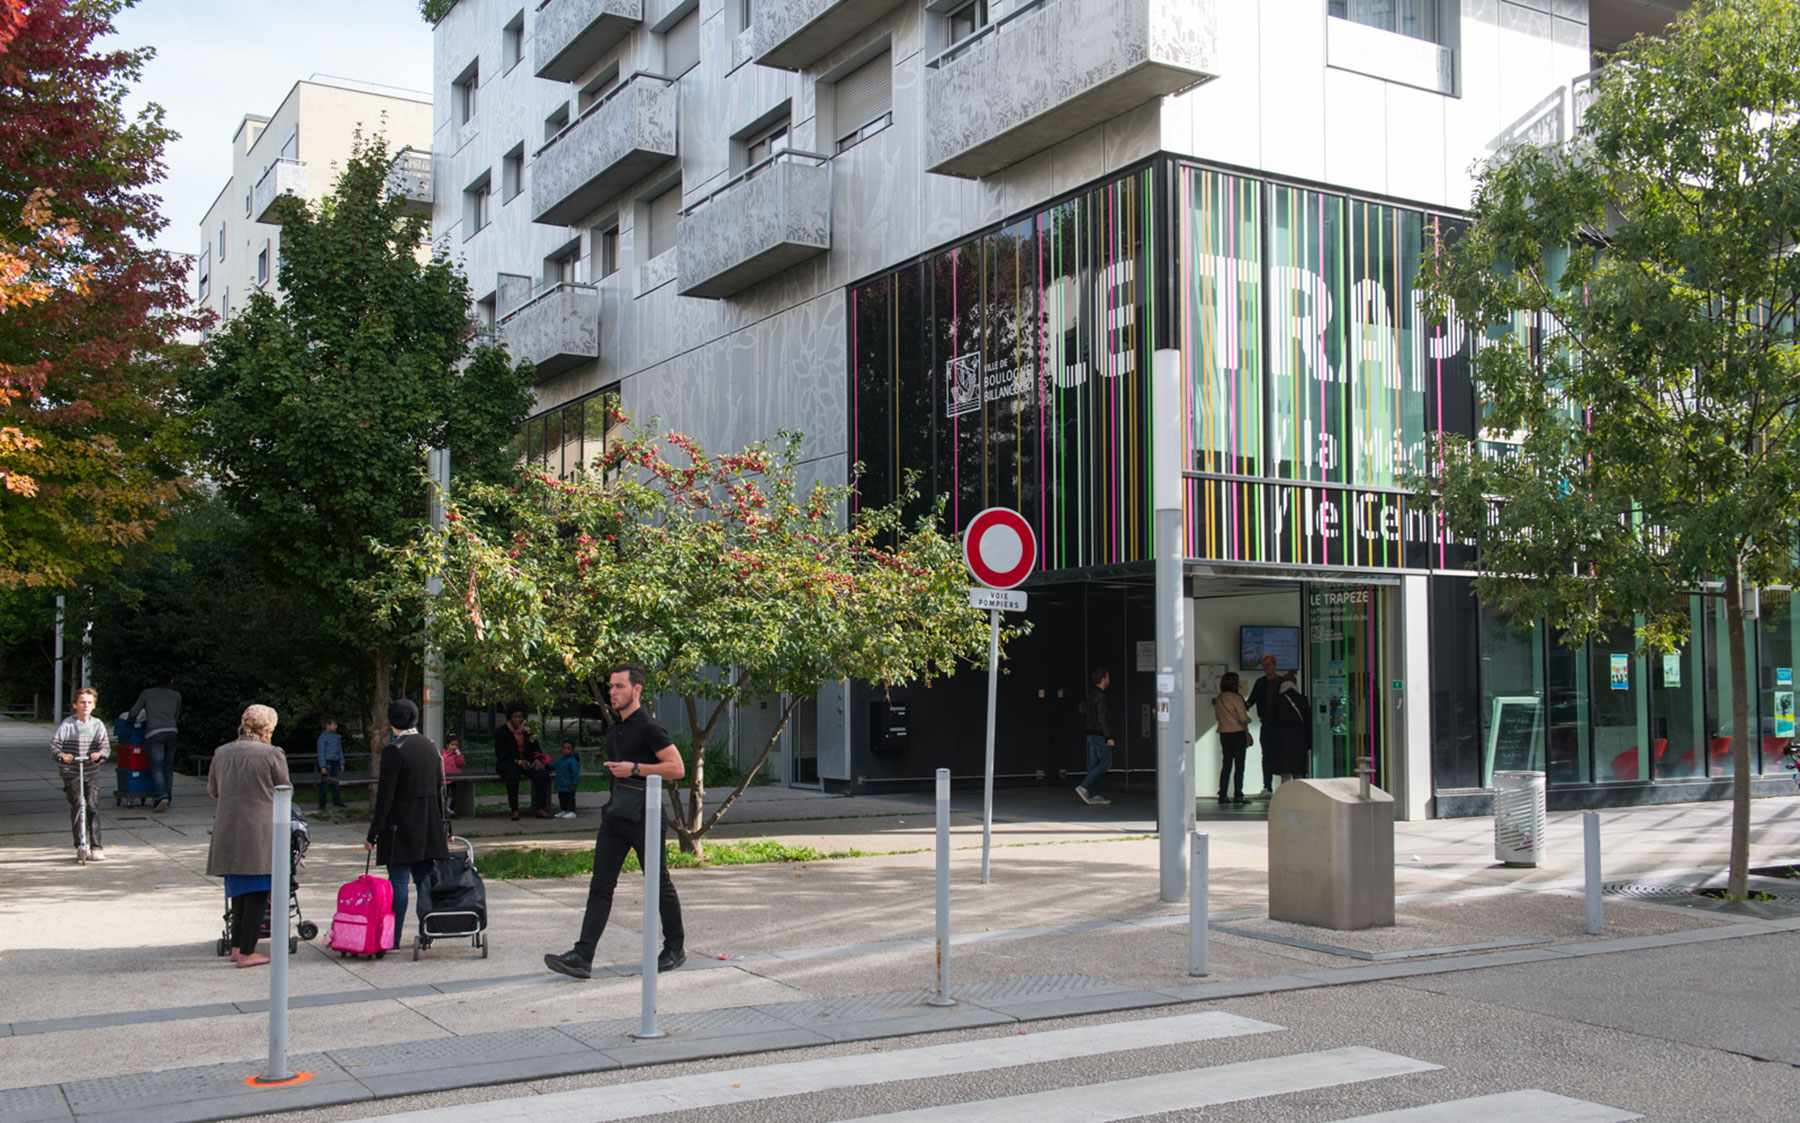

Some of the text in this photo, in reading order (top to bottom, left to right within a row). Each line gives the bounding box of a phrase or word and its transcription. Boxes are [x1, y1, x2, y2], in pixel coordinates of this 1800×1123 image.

[1050, 259, 1134, 389] LE
[1000, 358, 1008, 368] DE
[1355, 493, 1477, 546] Cent
[991, 592, 1009, 600] VOIE
[1310, 594, 1321, 606] LE
[978, 599, 1020, 609] POMPIERS
